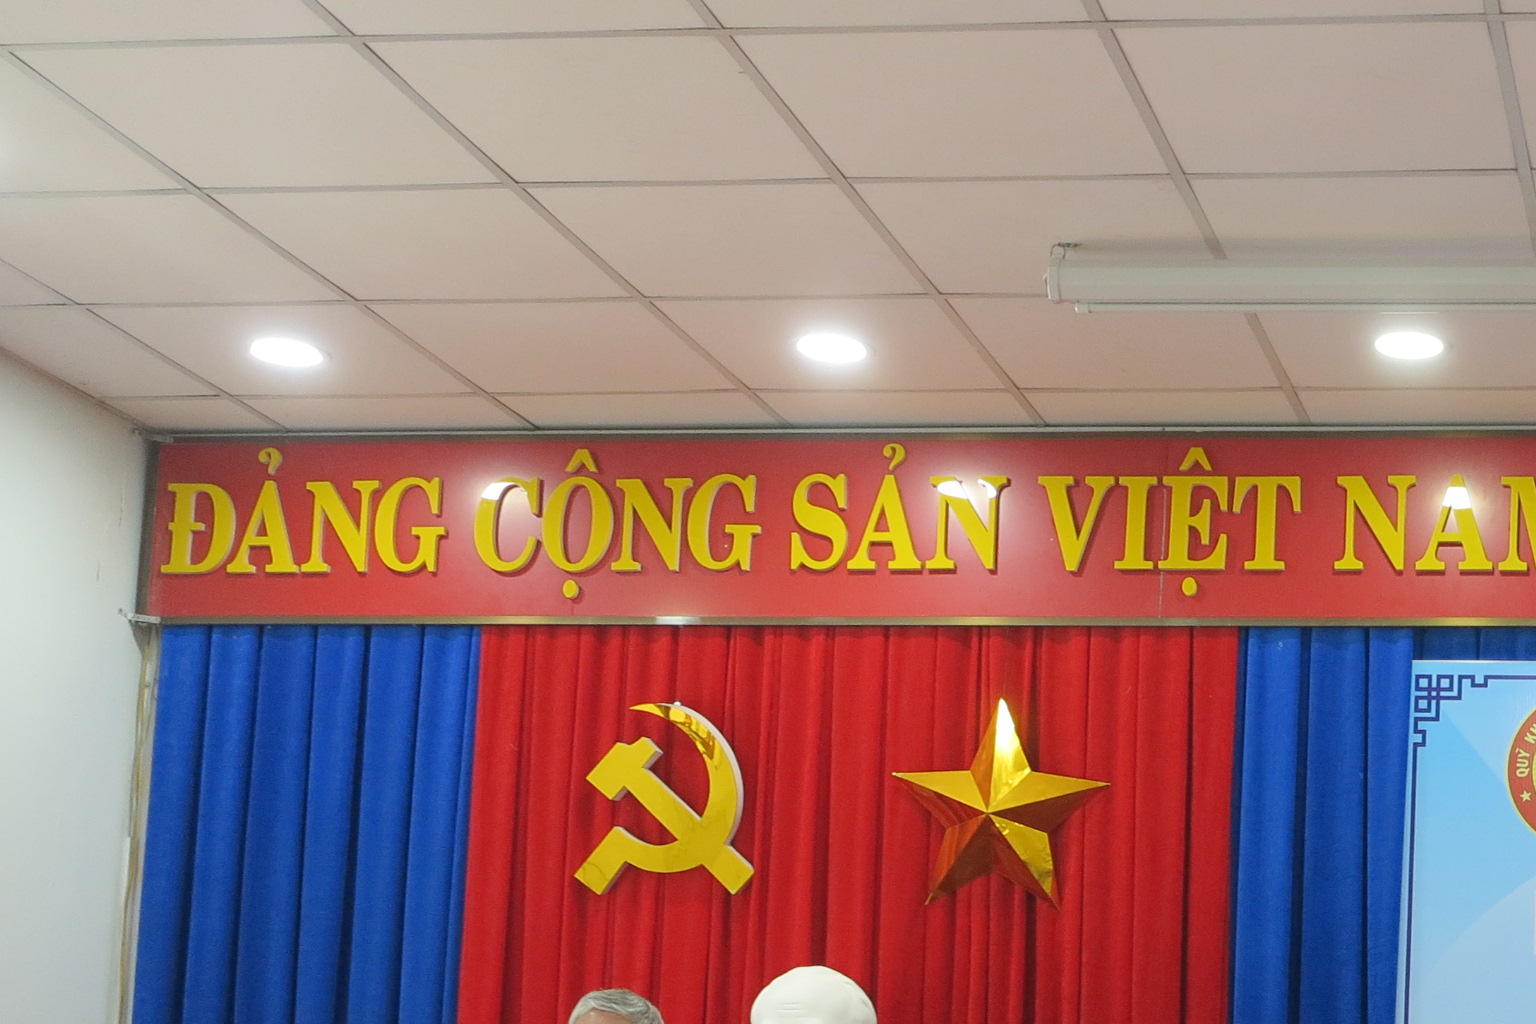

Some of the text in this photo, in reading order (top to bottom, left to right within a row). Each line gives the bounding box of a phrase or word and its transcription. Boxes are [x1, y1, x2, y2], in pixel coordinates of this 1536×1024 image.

[160, 447, 447, 575] ĐẢNG
[474, 448, 762, 600] CỘNG
[790, 443, 1011, 573] SẢN
[1037, 446, 1302, 597] VIỆT
[1515, 747, 1531, 778] QUỸ
